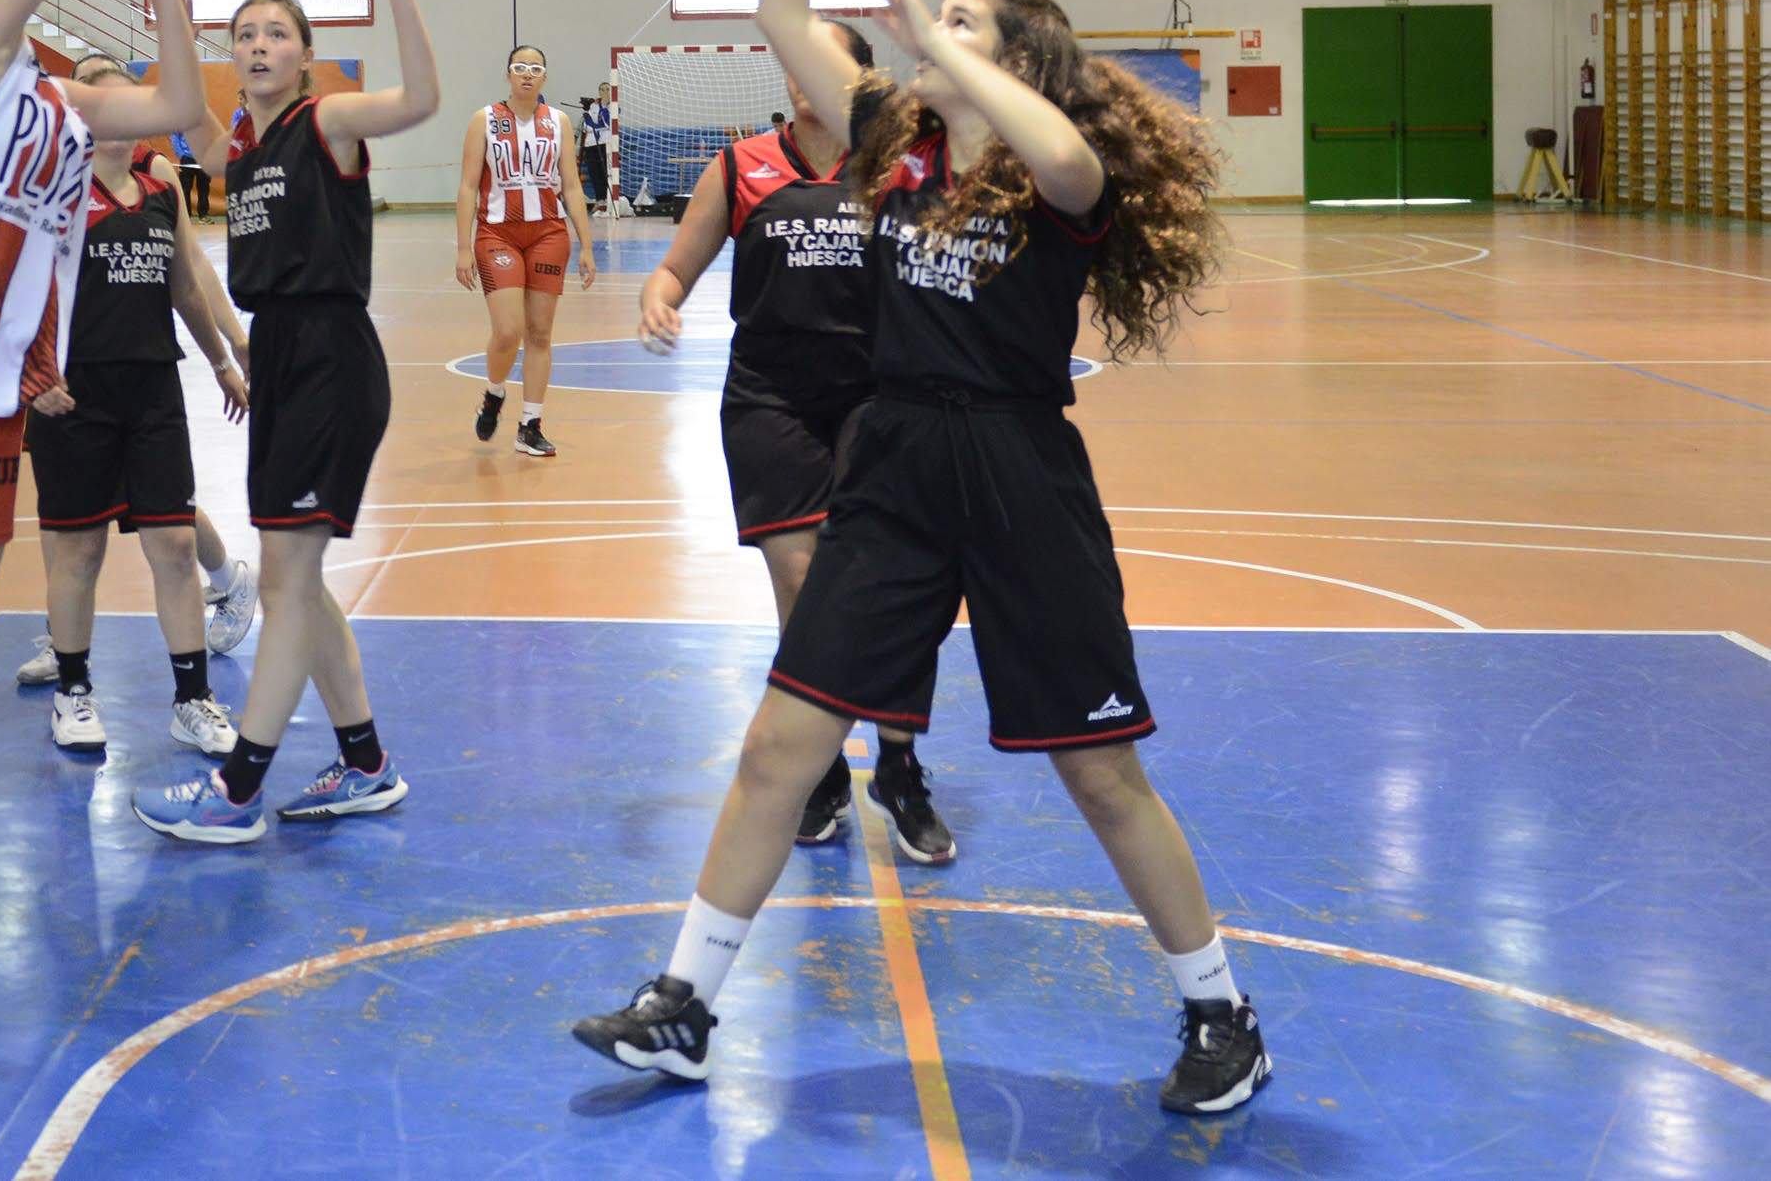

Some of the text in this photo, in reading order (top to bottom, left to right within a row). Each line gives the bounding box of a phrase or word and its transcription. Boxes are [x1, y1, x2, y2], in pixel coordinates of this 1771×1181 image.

[490, 120, 512, 135] 39
[765, 218, 874, 237] I.E.S. RAMO
[785, 234, 865, 251] Y CAJAL
[88, 243, 128, 258] I.E.S.
[108, 256, 167, 271] Y CAJAL
[787, 250, 864, 268] HUESCA
[108, 269, 165, 284] HUESCA
